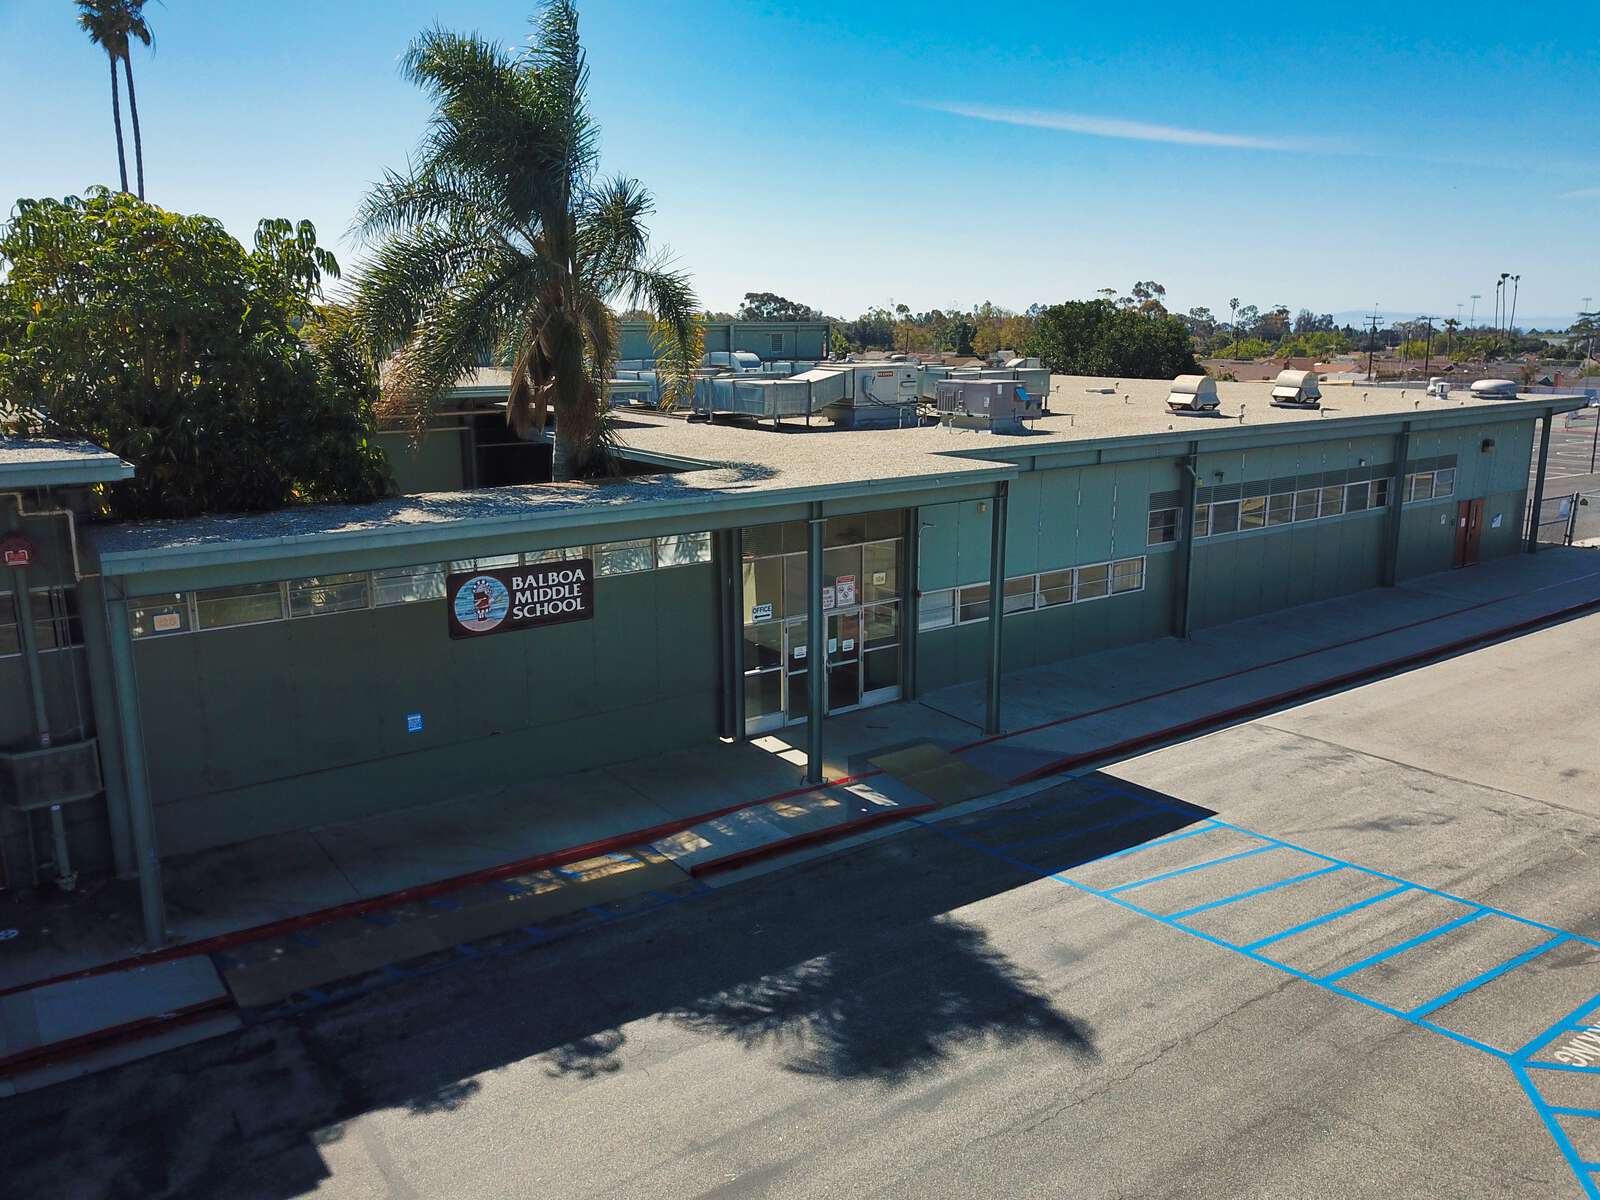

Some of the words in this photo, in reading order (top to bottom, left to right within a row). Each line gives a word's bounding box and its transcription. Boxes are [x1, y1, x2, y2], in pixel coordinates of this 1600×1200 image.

[512, 569, 585, 590] BALBOA
[515, 584, 582, 604] MIDDLE
[513, 598, 585, 619] SCHOOL
[752, 605, 772, 614] OFFICE
